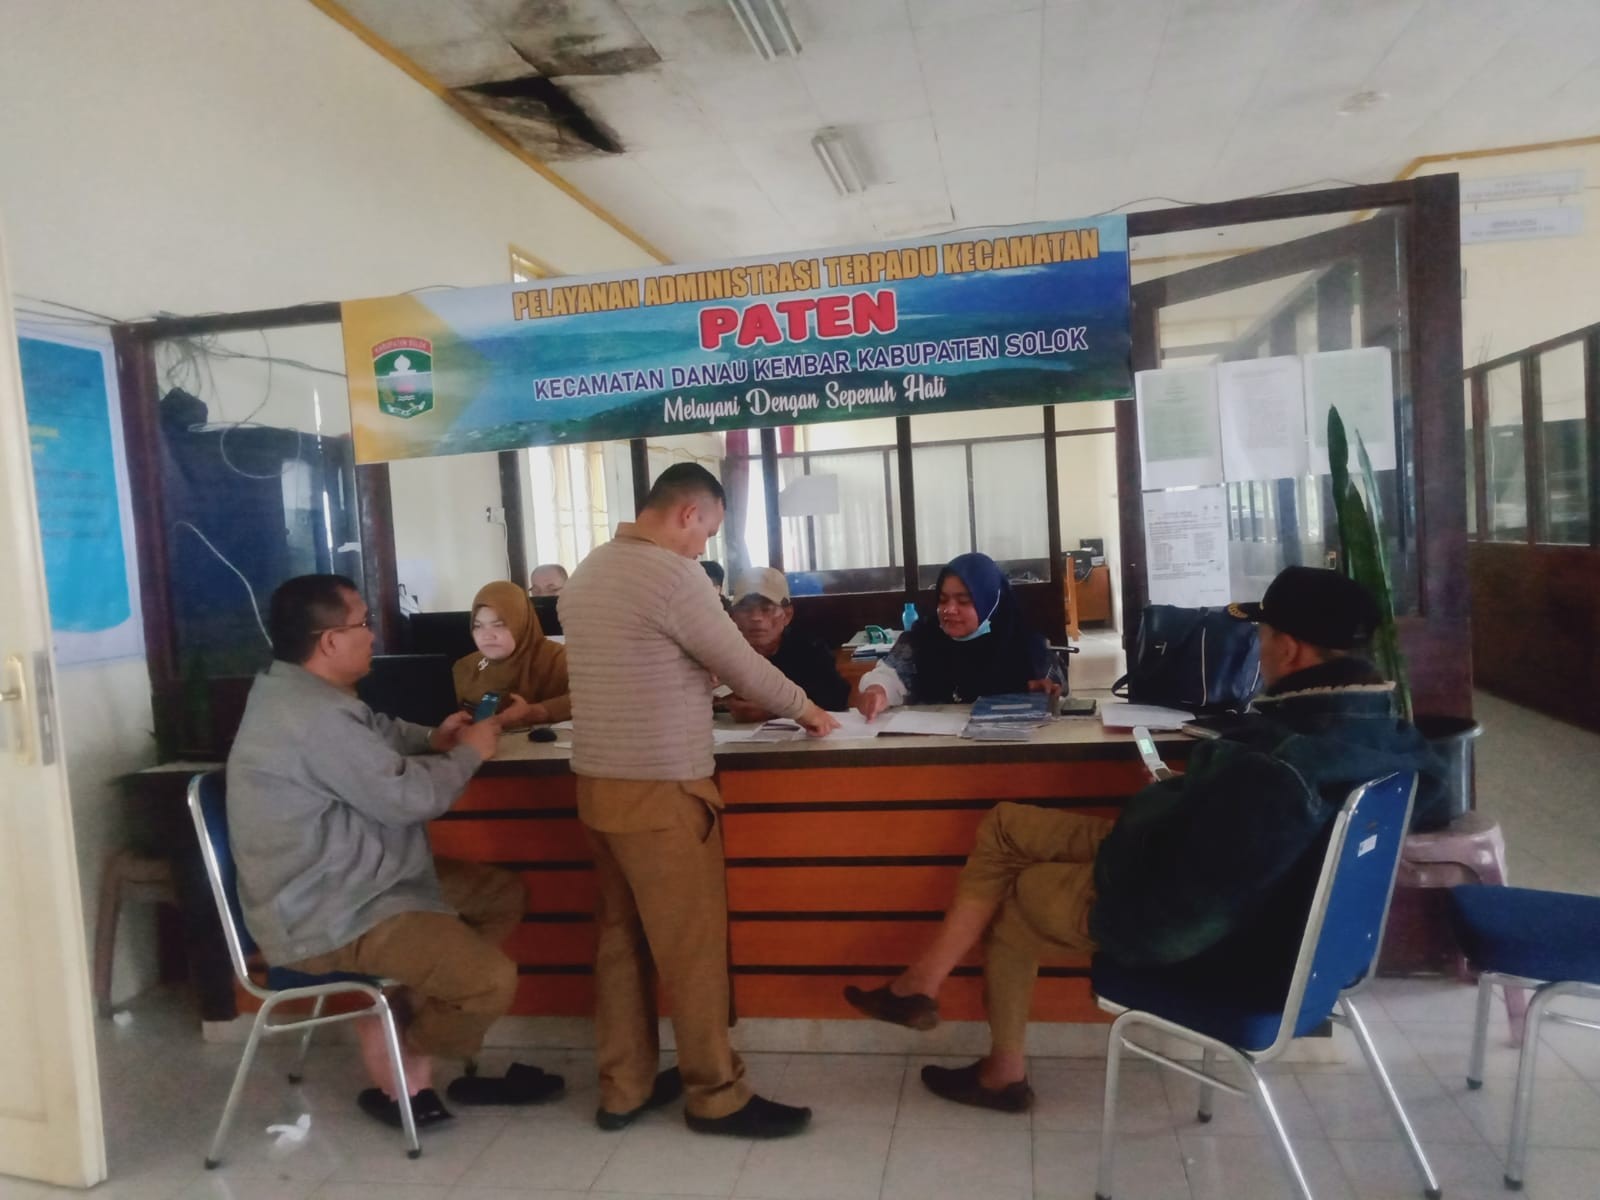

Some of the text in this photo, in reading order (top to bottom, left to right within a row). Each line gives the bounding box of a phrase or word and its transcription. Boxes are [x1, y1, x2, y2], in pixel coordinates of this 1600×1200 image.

[512, 229, 1099, 320] PELAYANAN ADMINISTRASI TERPADU KECAMATAN
[699, 290, 897, 350] PATEN
[534, 327, 1089, 402] KECAMATAN DANAU KEMBAR KABUPATEN SOLOK
[663, 373, 947, 425] Melayani Dengan Sepenuh Hati
